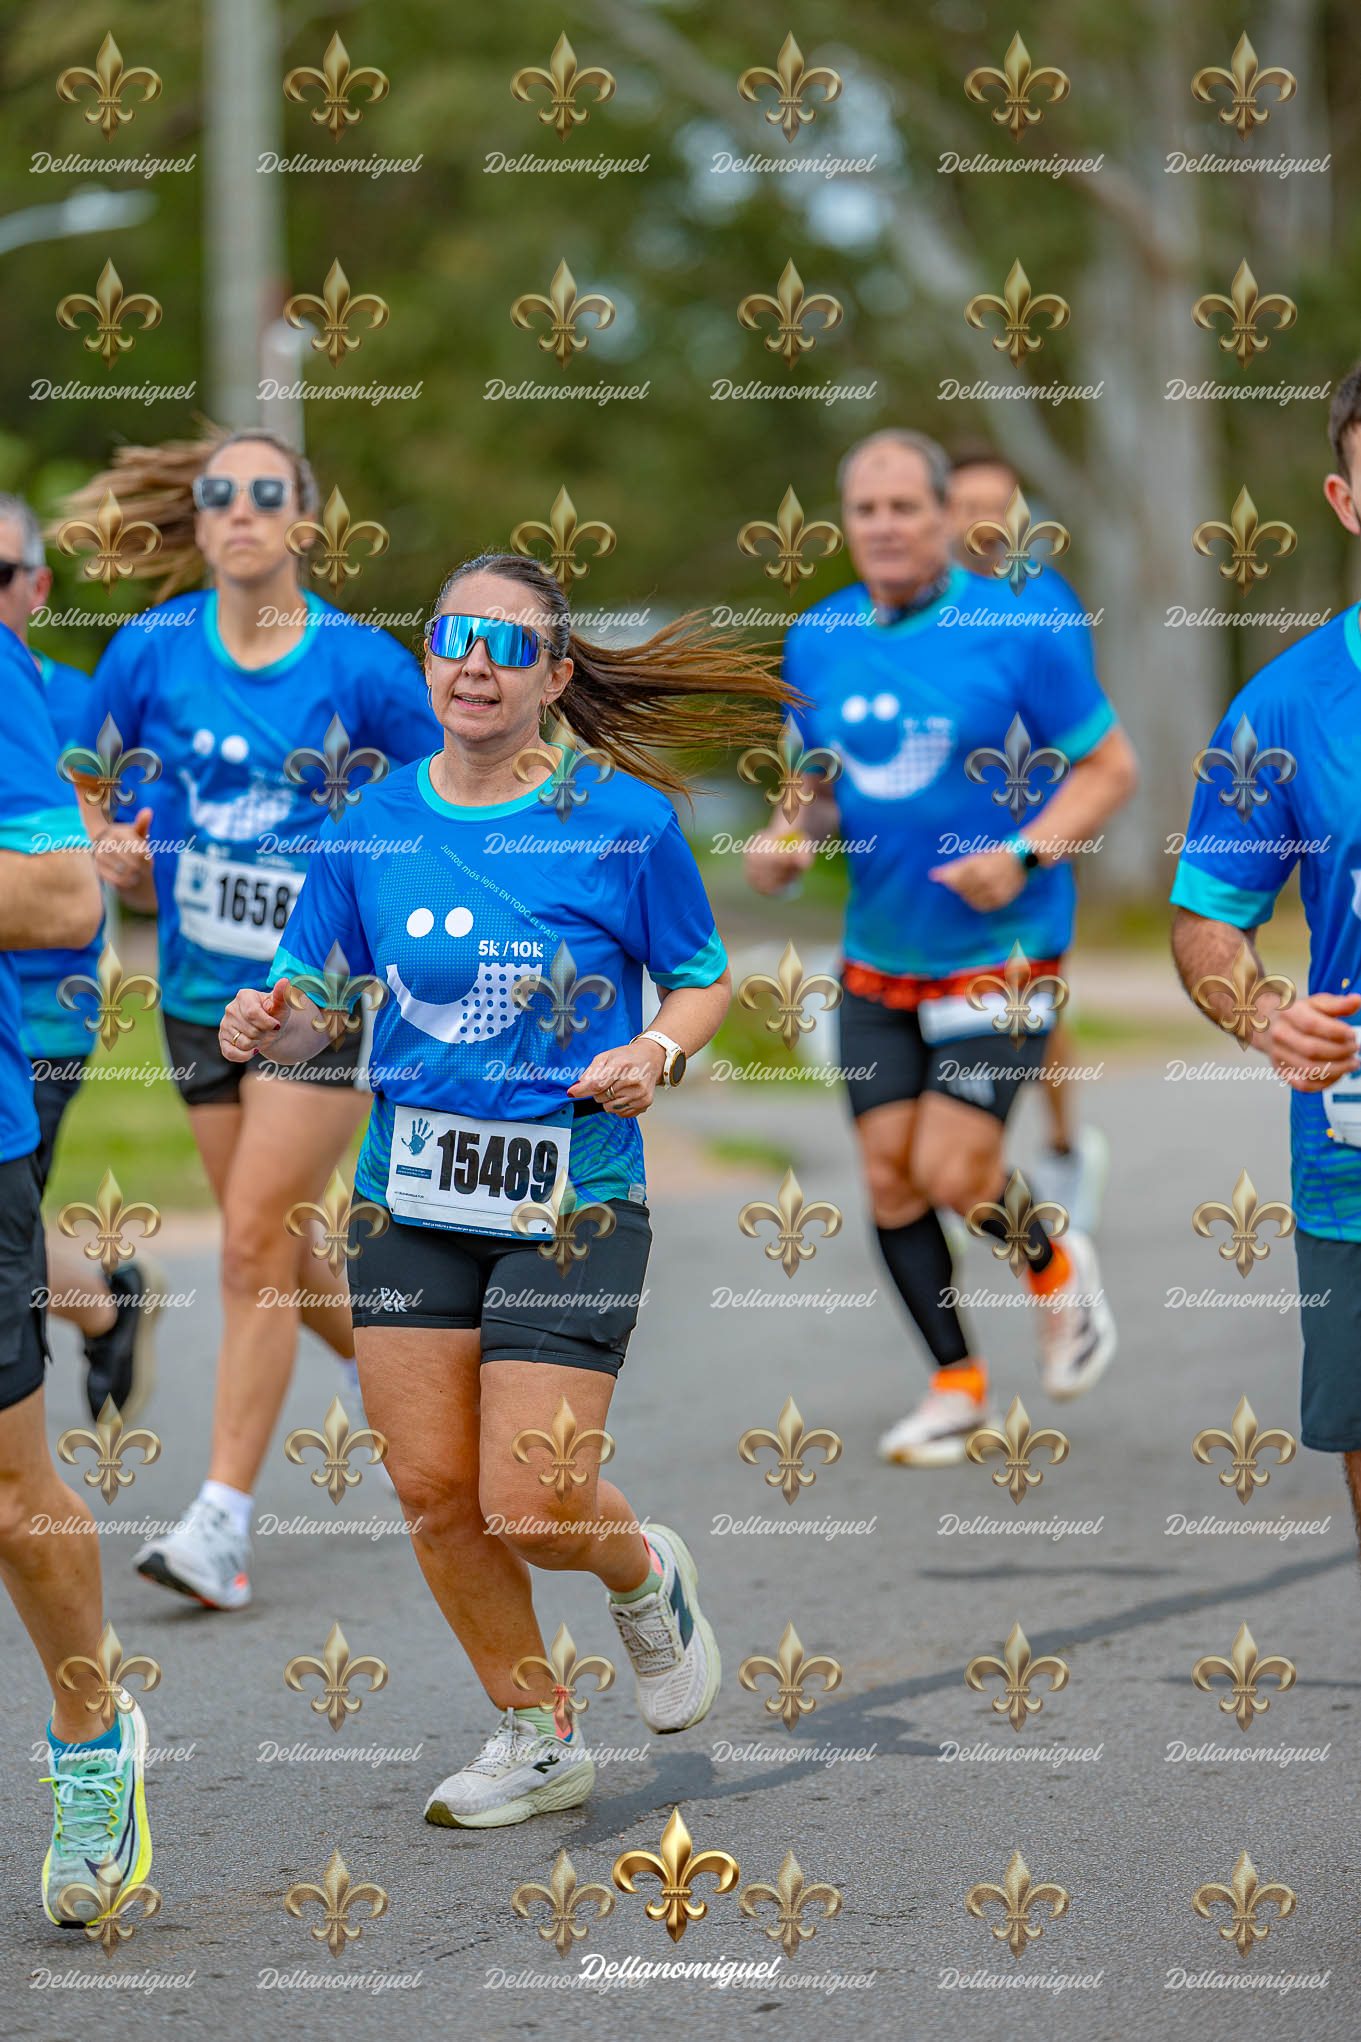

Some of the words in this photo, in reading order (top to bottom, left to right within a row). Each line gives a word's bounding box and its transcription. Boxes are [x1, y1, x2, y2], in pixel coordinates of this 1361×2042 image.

[217, 872, 300, 931] 1658
[440, 844, 463, 867] Juntos
[480, 875, 500, 893] lejos
[498, 889, 512, 902] EN
[529, 915, 540, 928] EL
[437, 1129, 559, 1204] 15489
